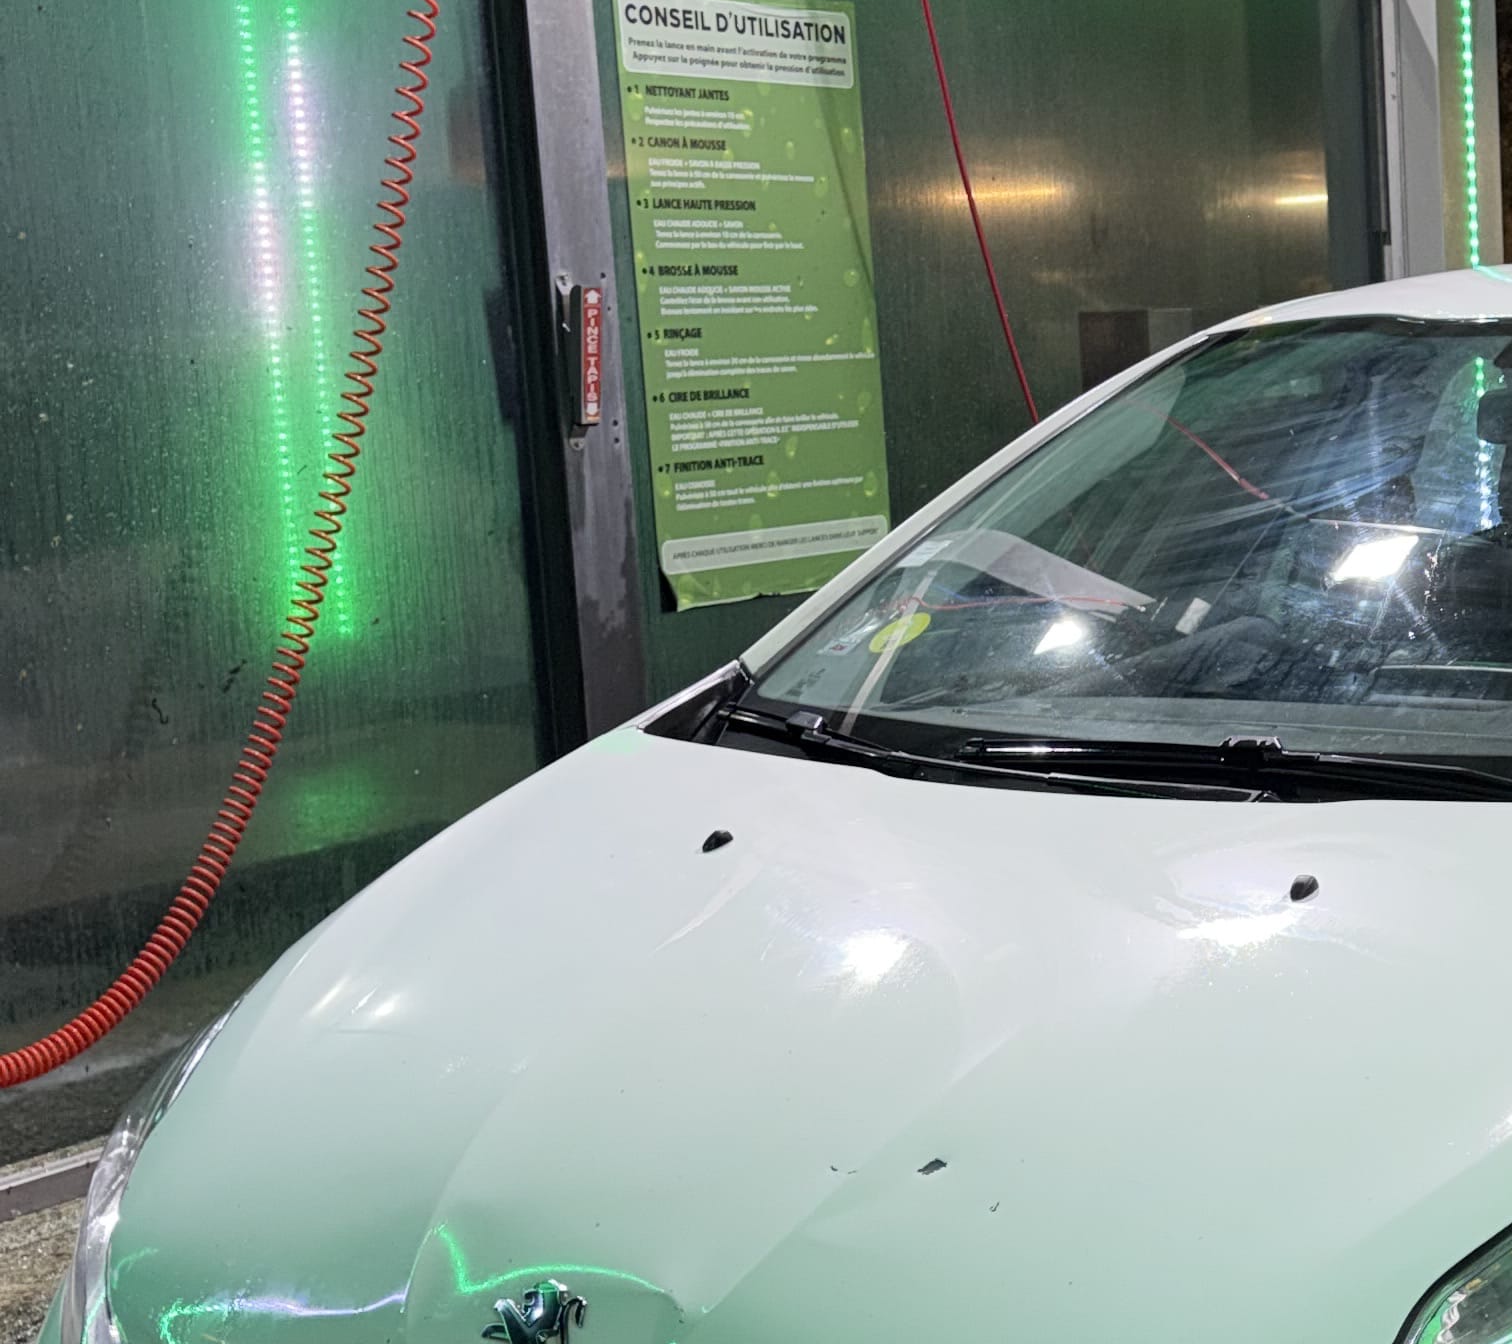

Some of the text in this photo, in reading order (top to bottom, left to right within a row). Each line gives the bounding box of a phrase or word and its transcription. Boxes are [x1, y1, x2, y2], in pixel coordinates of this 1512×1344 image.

[624, 3, 845, 44] CONSEIL D'UTILISATION
[645, 85, 696, 99] NETTOYANT
[698, 88, 730, 101] JANTES
[638, 136, 727, 152] 2 CANON À MOUSSE
[643, 197, 756, 211] 3 LANCE HAUTE PRESSION
[649, 263, 738, 276] 4 BROSSE À MOUSSE
[655, 327, 702, 341] 5 RINÇAGE
[586, 308, 599, 402] PINCE TAPIS
[659, 388, 750, 403] 6 CIRE DE BRILLANCE
[665, 455, 764, 474] 7 FINITION ANTI-TRACE
